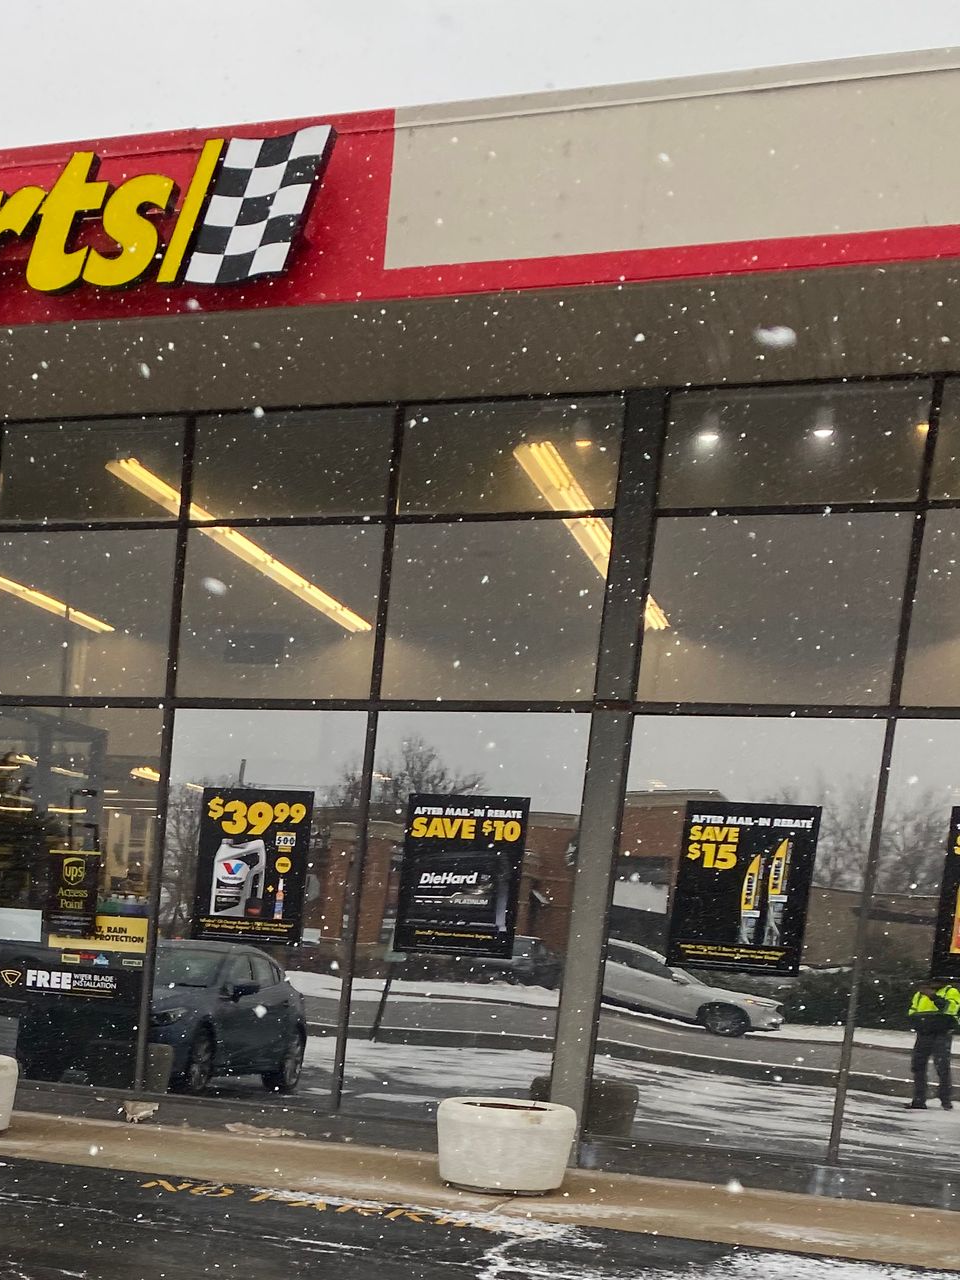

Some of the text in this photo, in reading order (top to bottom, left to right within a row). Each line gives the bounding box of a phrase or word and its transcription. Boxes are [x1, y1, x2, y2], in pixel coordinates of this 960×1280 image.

[414, 806, 523, 819] AFTER MAIL-IN REBATE
[692, 814, 813, 829] AFTER MAIL-IN REBATE
[411, 817, 522, 842] SAVE $10
[689, 825, 740, 843] SAVE
[686, 842, 737, 870] $15
[65, 865, 85, 881] ups
[419, 871, 478, 884] DieHard
[57, 887, 88, 898] Access
[60, 898, 84, 910] Point
[107, 926, 128, 935] RAIN
[94, 934, 144, 944] PROTECTION
[26, 969, 72, 989] FREE
[73, 973, 114, 983] WIPER BLADE
[73, 980, 117, 990] INSTALLATION
[141, 1178, 235, 1197] NO
